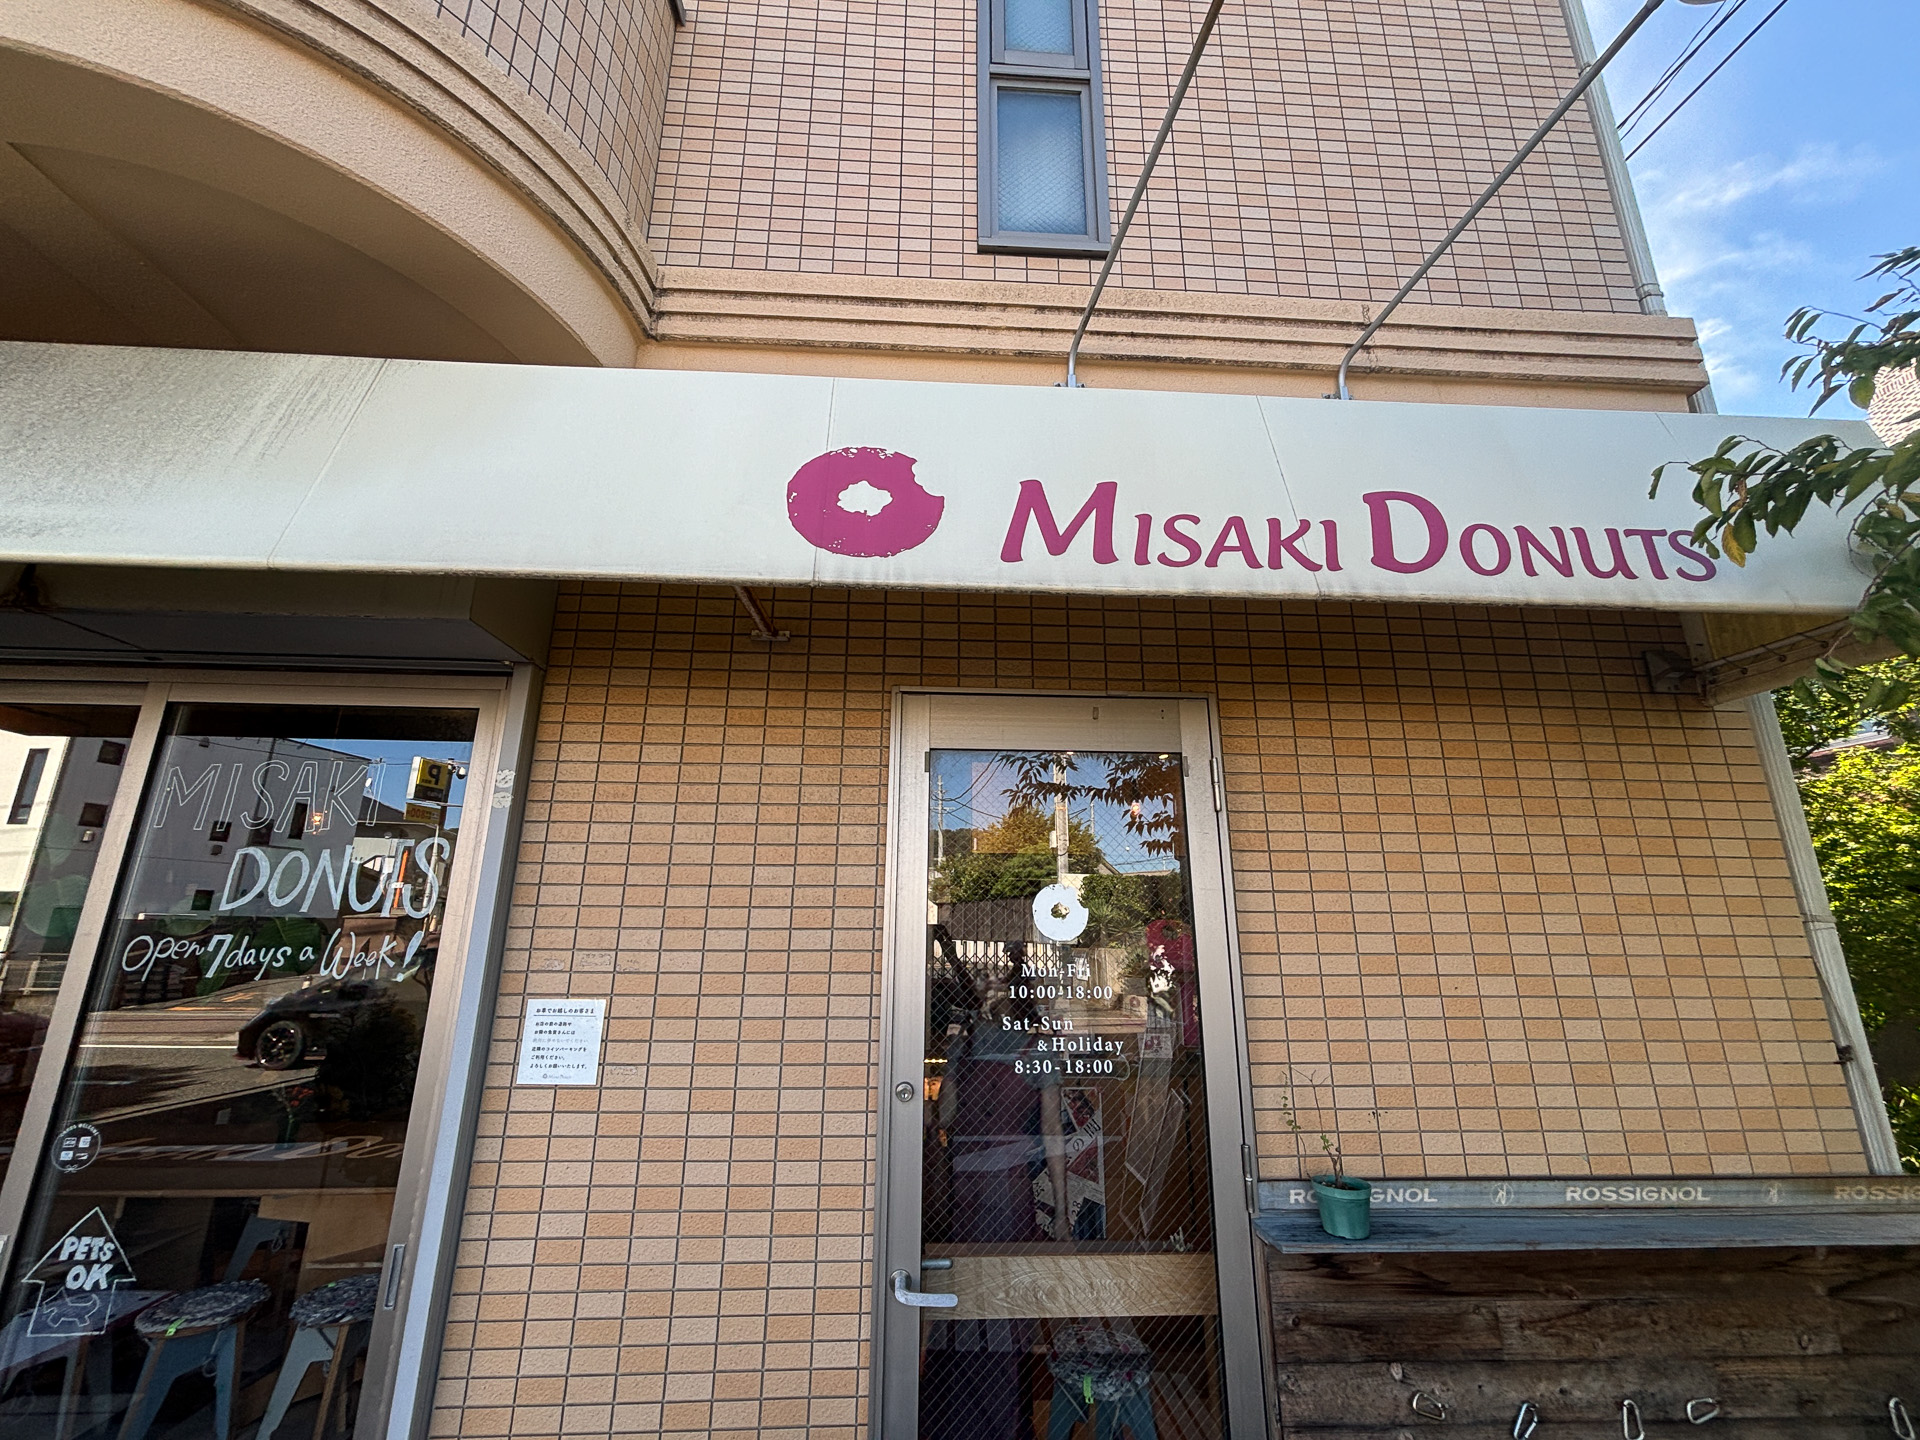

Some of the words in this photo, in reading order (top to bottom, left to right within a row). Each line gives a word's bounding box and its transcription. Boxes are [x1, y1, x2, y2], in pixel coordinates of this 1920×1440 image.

[1000, 479, 1343, 572] MISAKI
[1363, 491, 1717, 582] DONUTS
[153, 760, 386, 833] MISAKI
[219, 837, 450, 919] DONUTS
[299, 946, 316, 961] a
[1021, 963, 1092, 978] Mon-Fri
[1009, 985, 1114, 999] 10:00-18:00
[1002, 1016, 1075, 1031] Sat-Sun
[1565, 1186, 1711, 1202] ROSSIGNOL
[58, 1235, 116, 1262] PETS
[65, 1263, 114, 1291] OK
